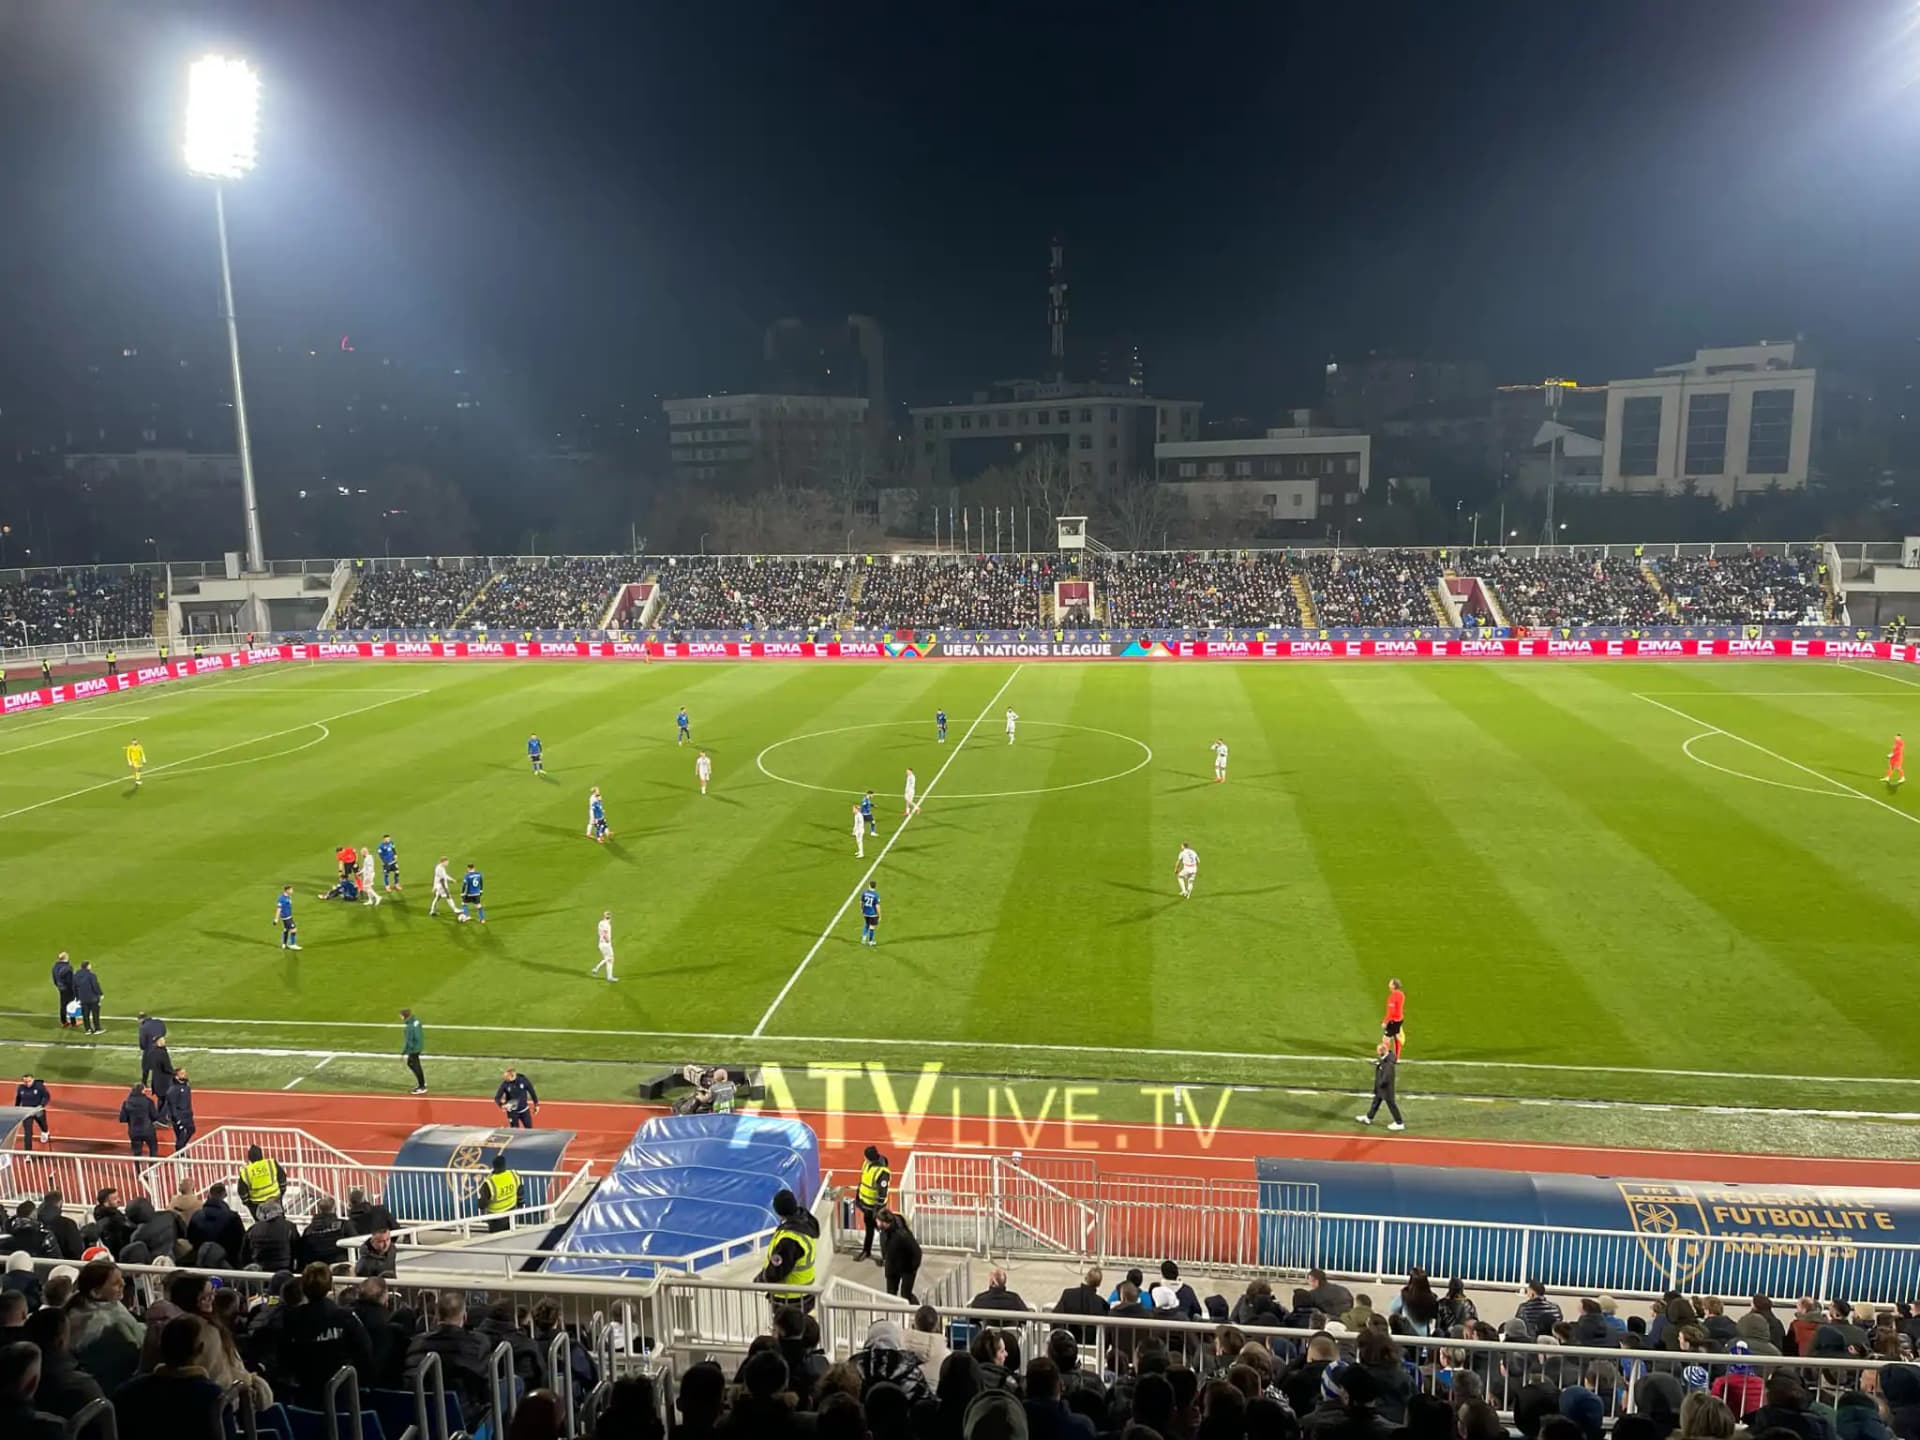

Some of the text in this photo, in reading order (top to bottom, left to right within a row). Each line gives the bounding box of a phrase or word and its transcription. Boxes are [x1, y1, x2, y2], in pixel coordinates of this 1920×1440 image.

[943, 644, 1112, 656] UEFA NATIONS LEAGUE
[1712, 1206, 1896, 1231] FUTBOLLIT E
